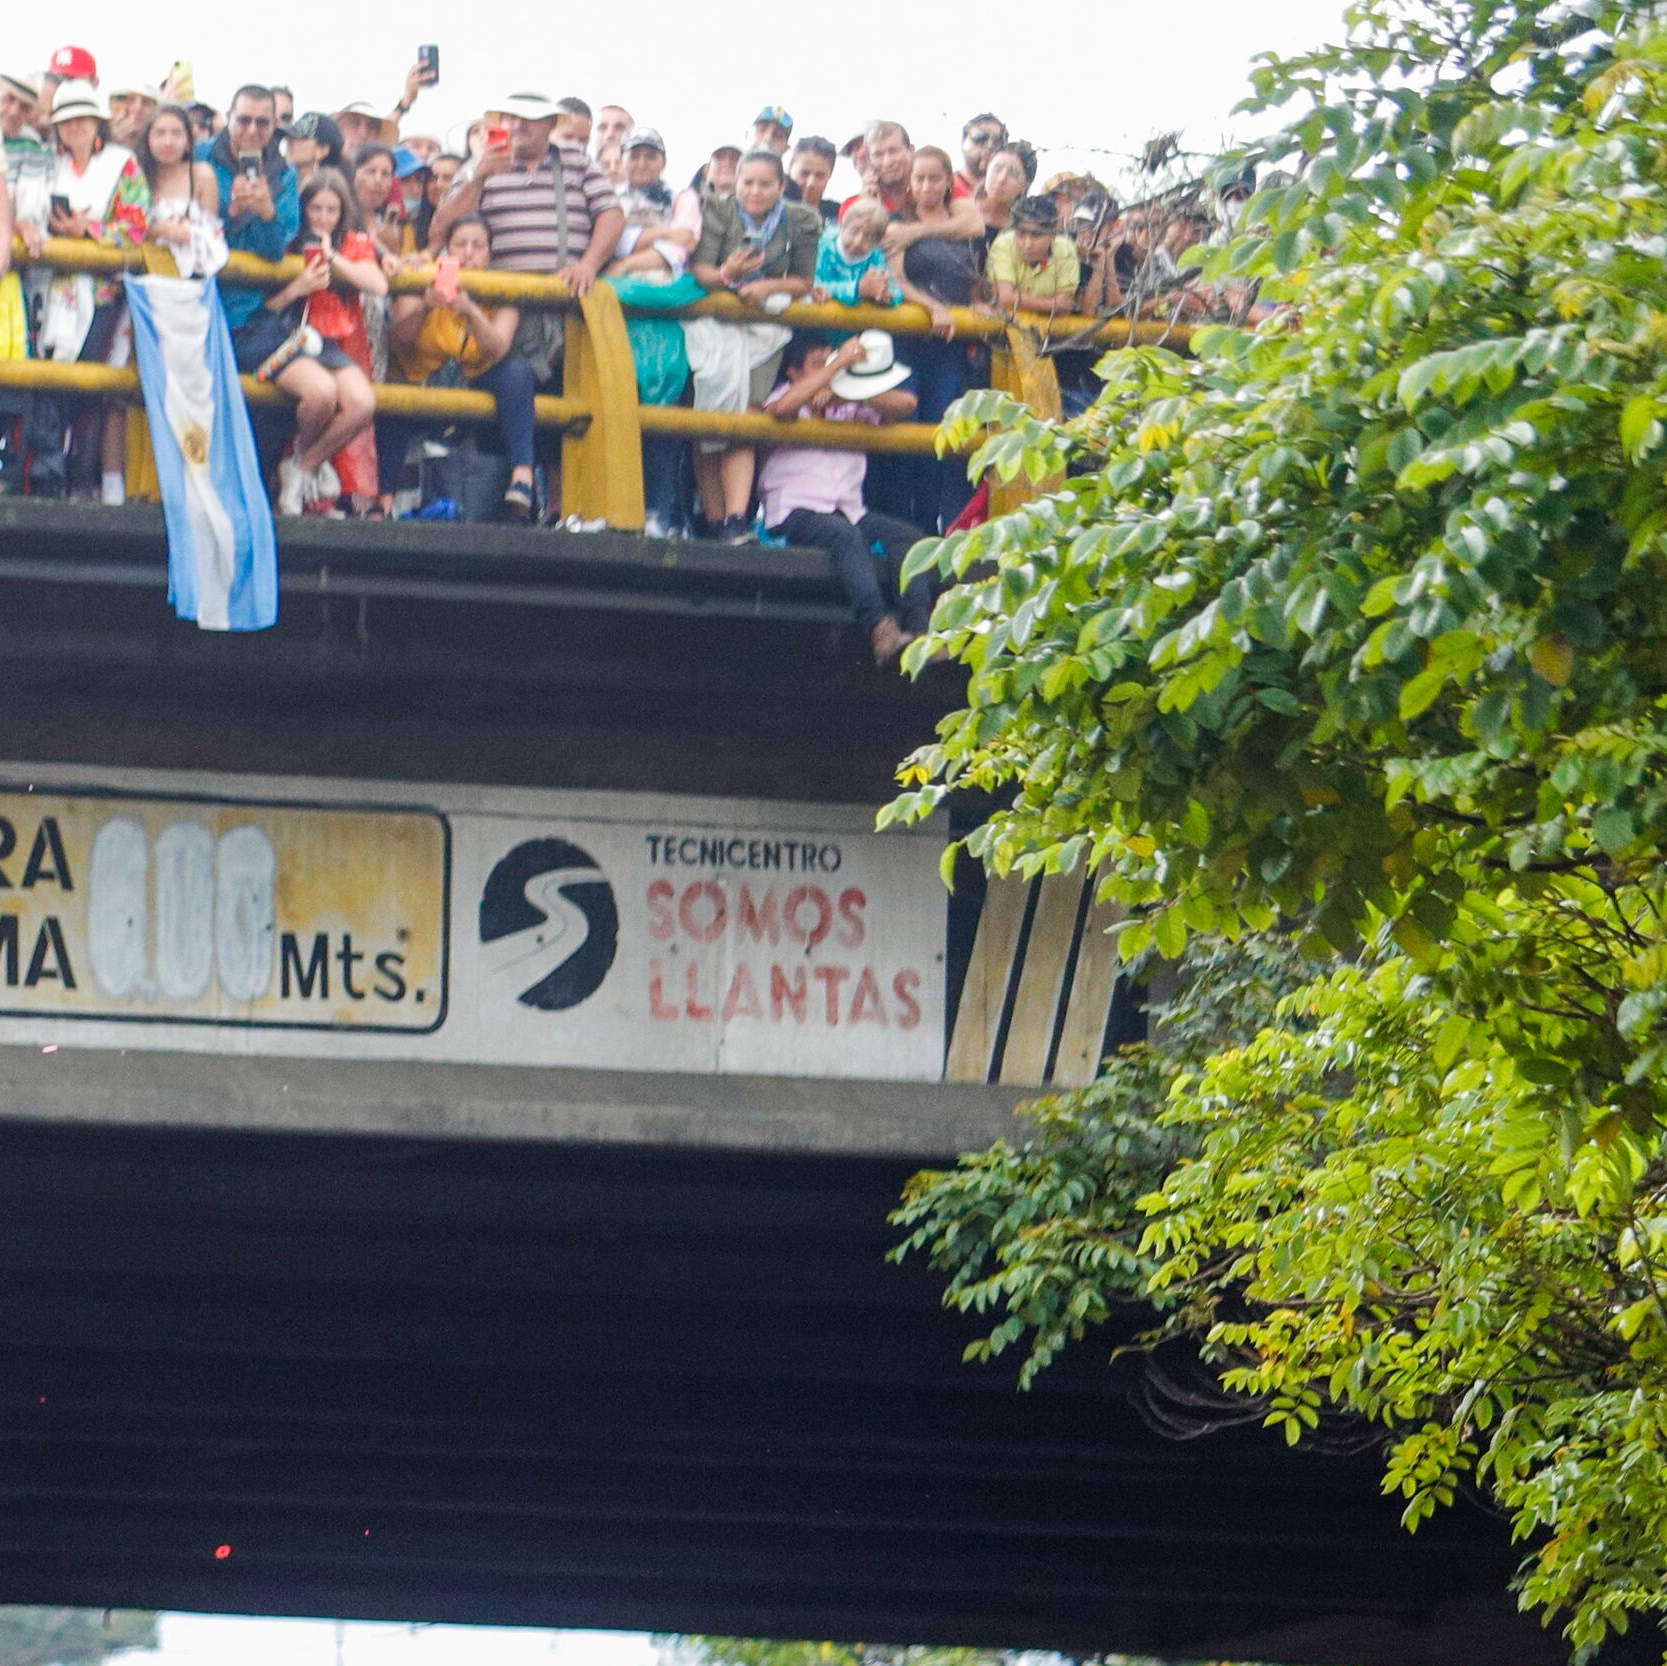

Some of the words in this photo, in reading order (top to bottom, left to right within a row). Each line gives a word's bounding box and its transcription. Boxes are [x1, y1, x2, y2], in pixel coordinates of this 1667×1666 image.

[646, 834, 842, 873] TECNICENTRO
[645, 878, 867, 949] SOMOS
[279, 931, 426, 1004] Mts.
[648, 957, 922, 1029] LLANTAS
